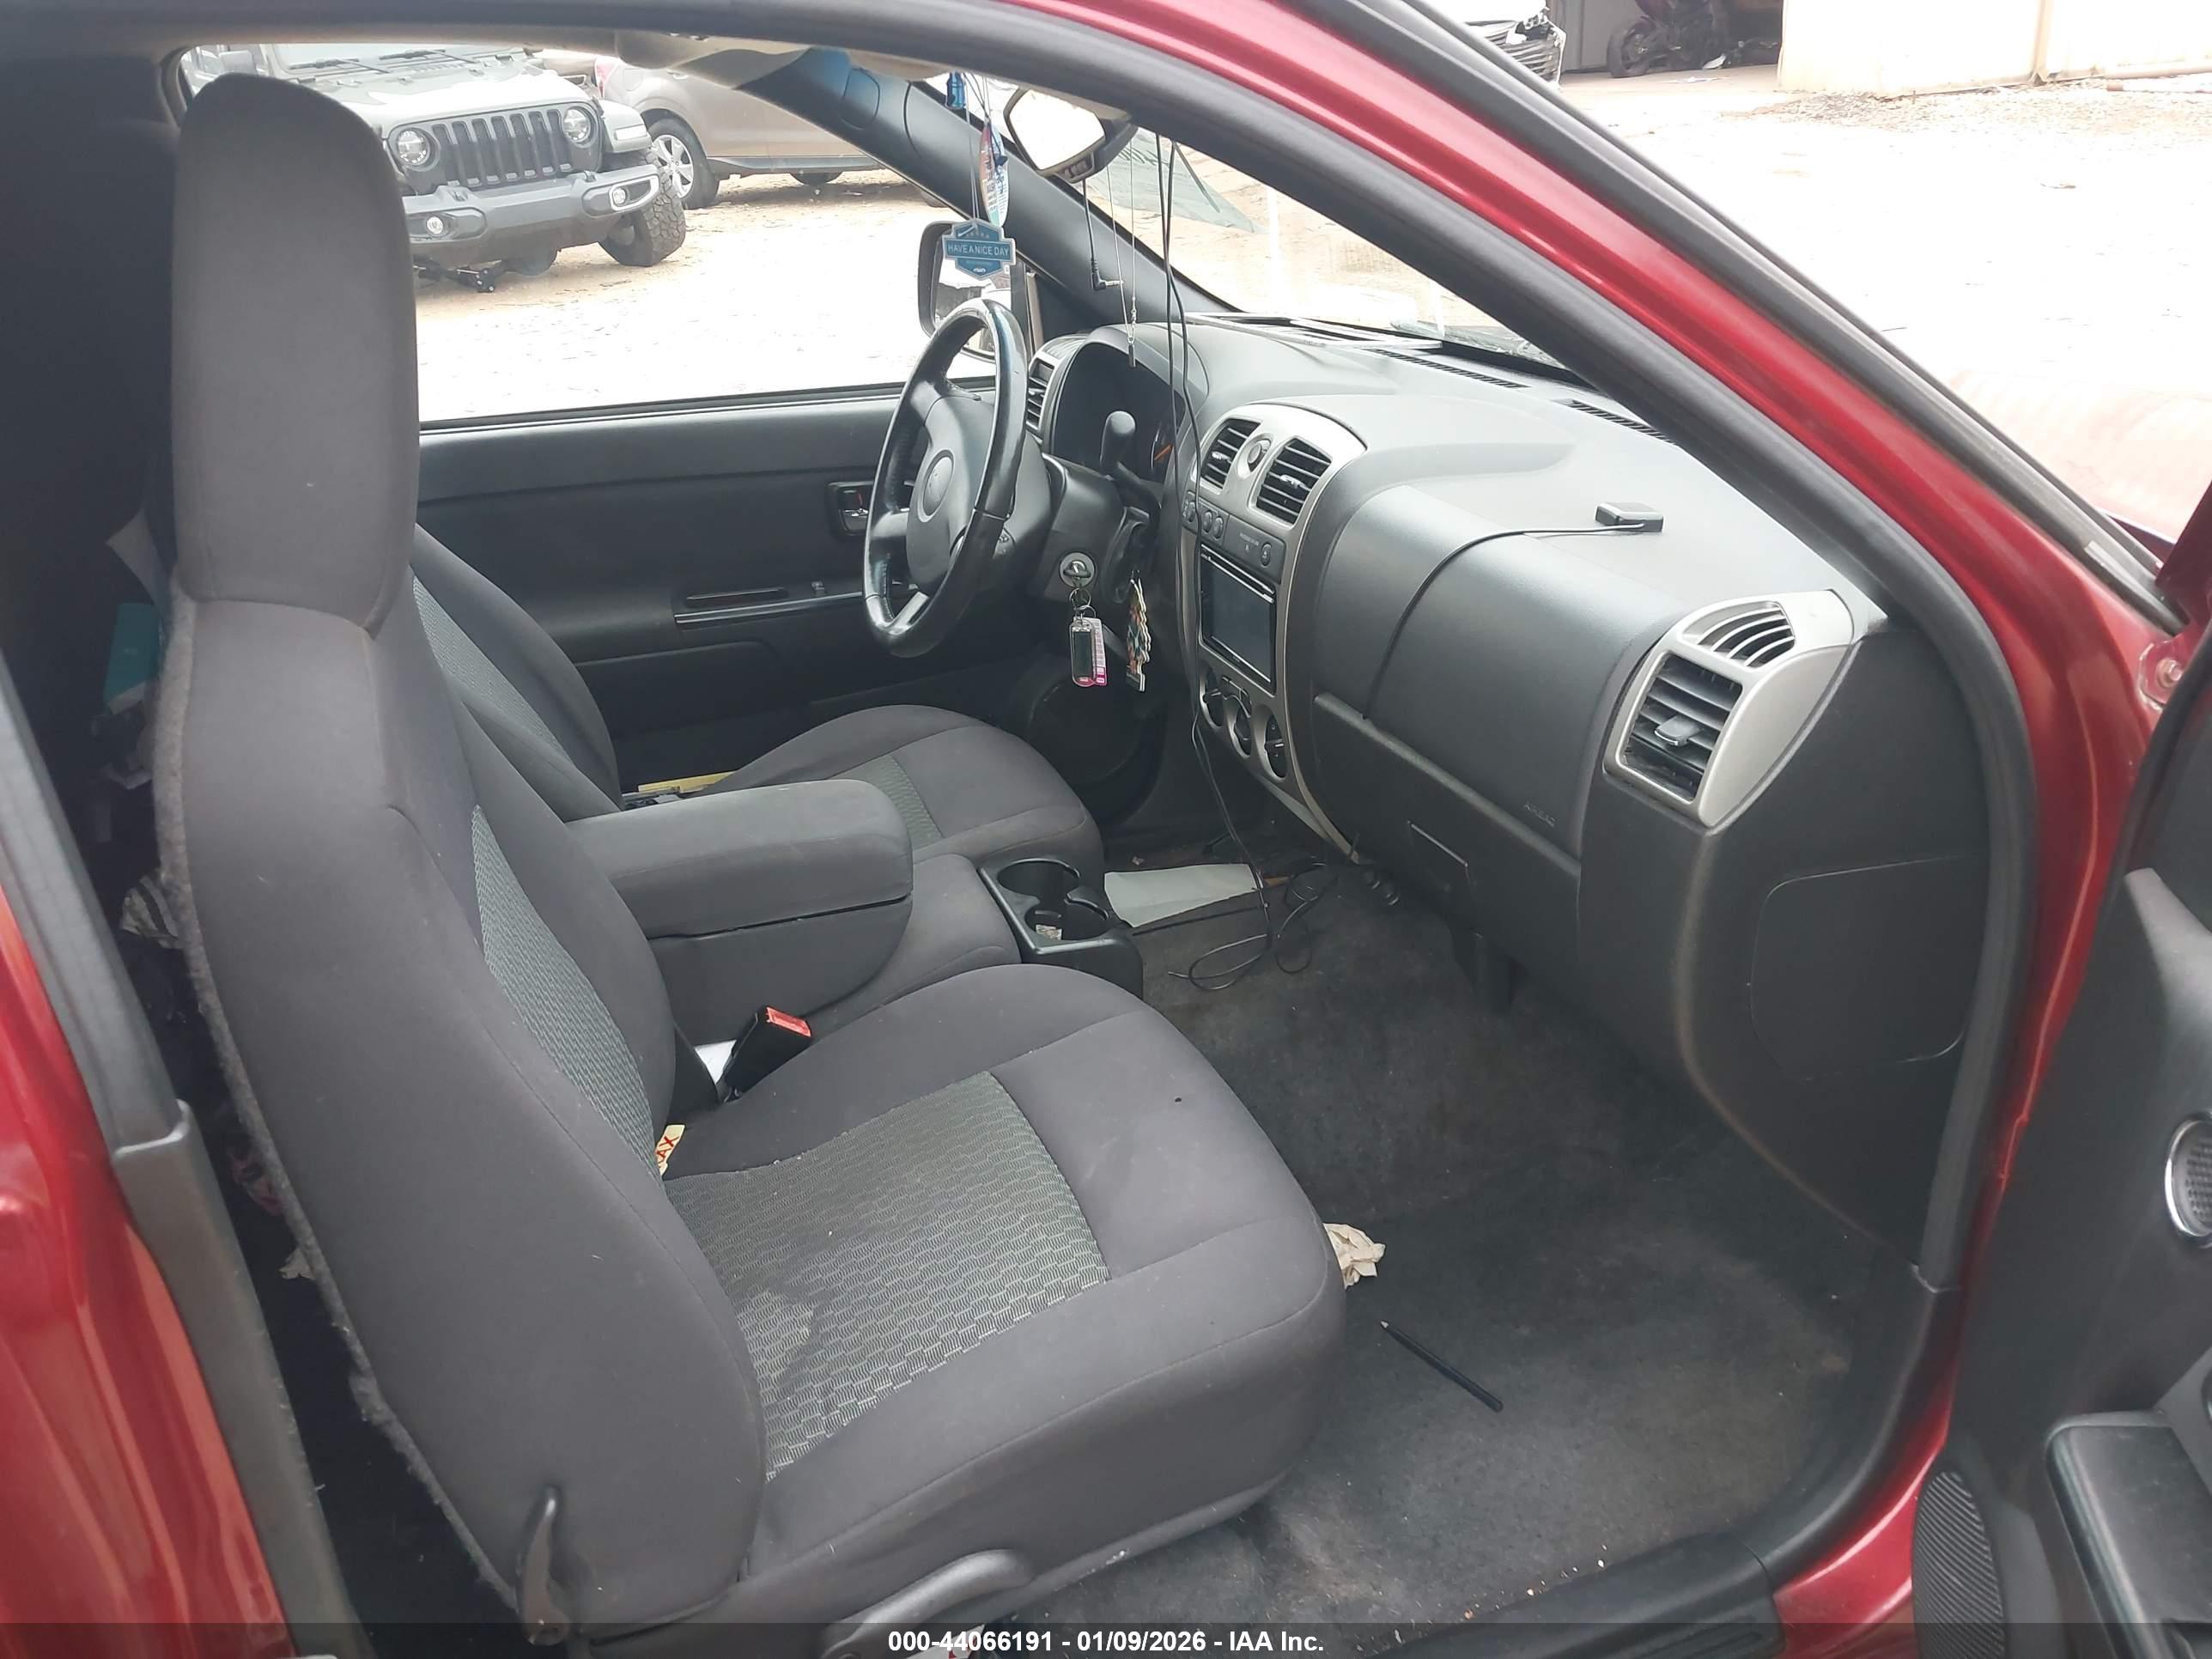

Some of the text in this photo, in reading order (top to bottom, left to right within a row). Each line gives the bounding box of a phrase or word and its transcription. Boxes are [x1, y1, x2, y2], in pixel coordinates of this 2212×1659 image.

[947, 243, 1010, 256] HAVE A NICE DAY
